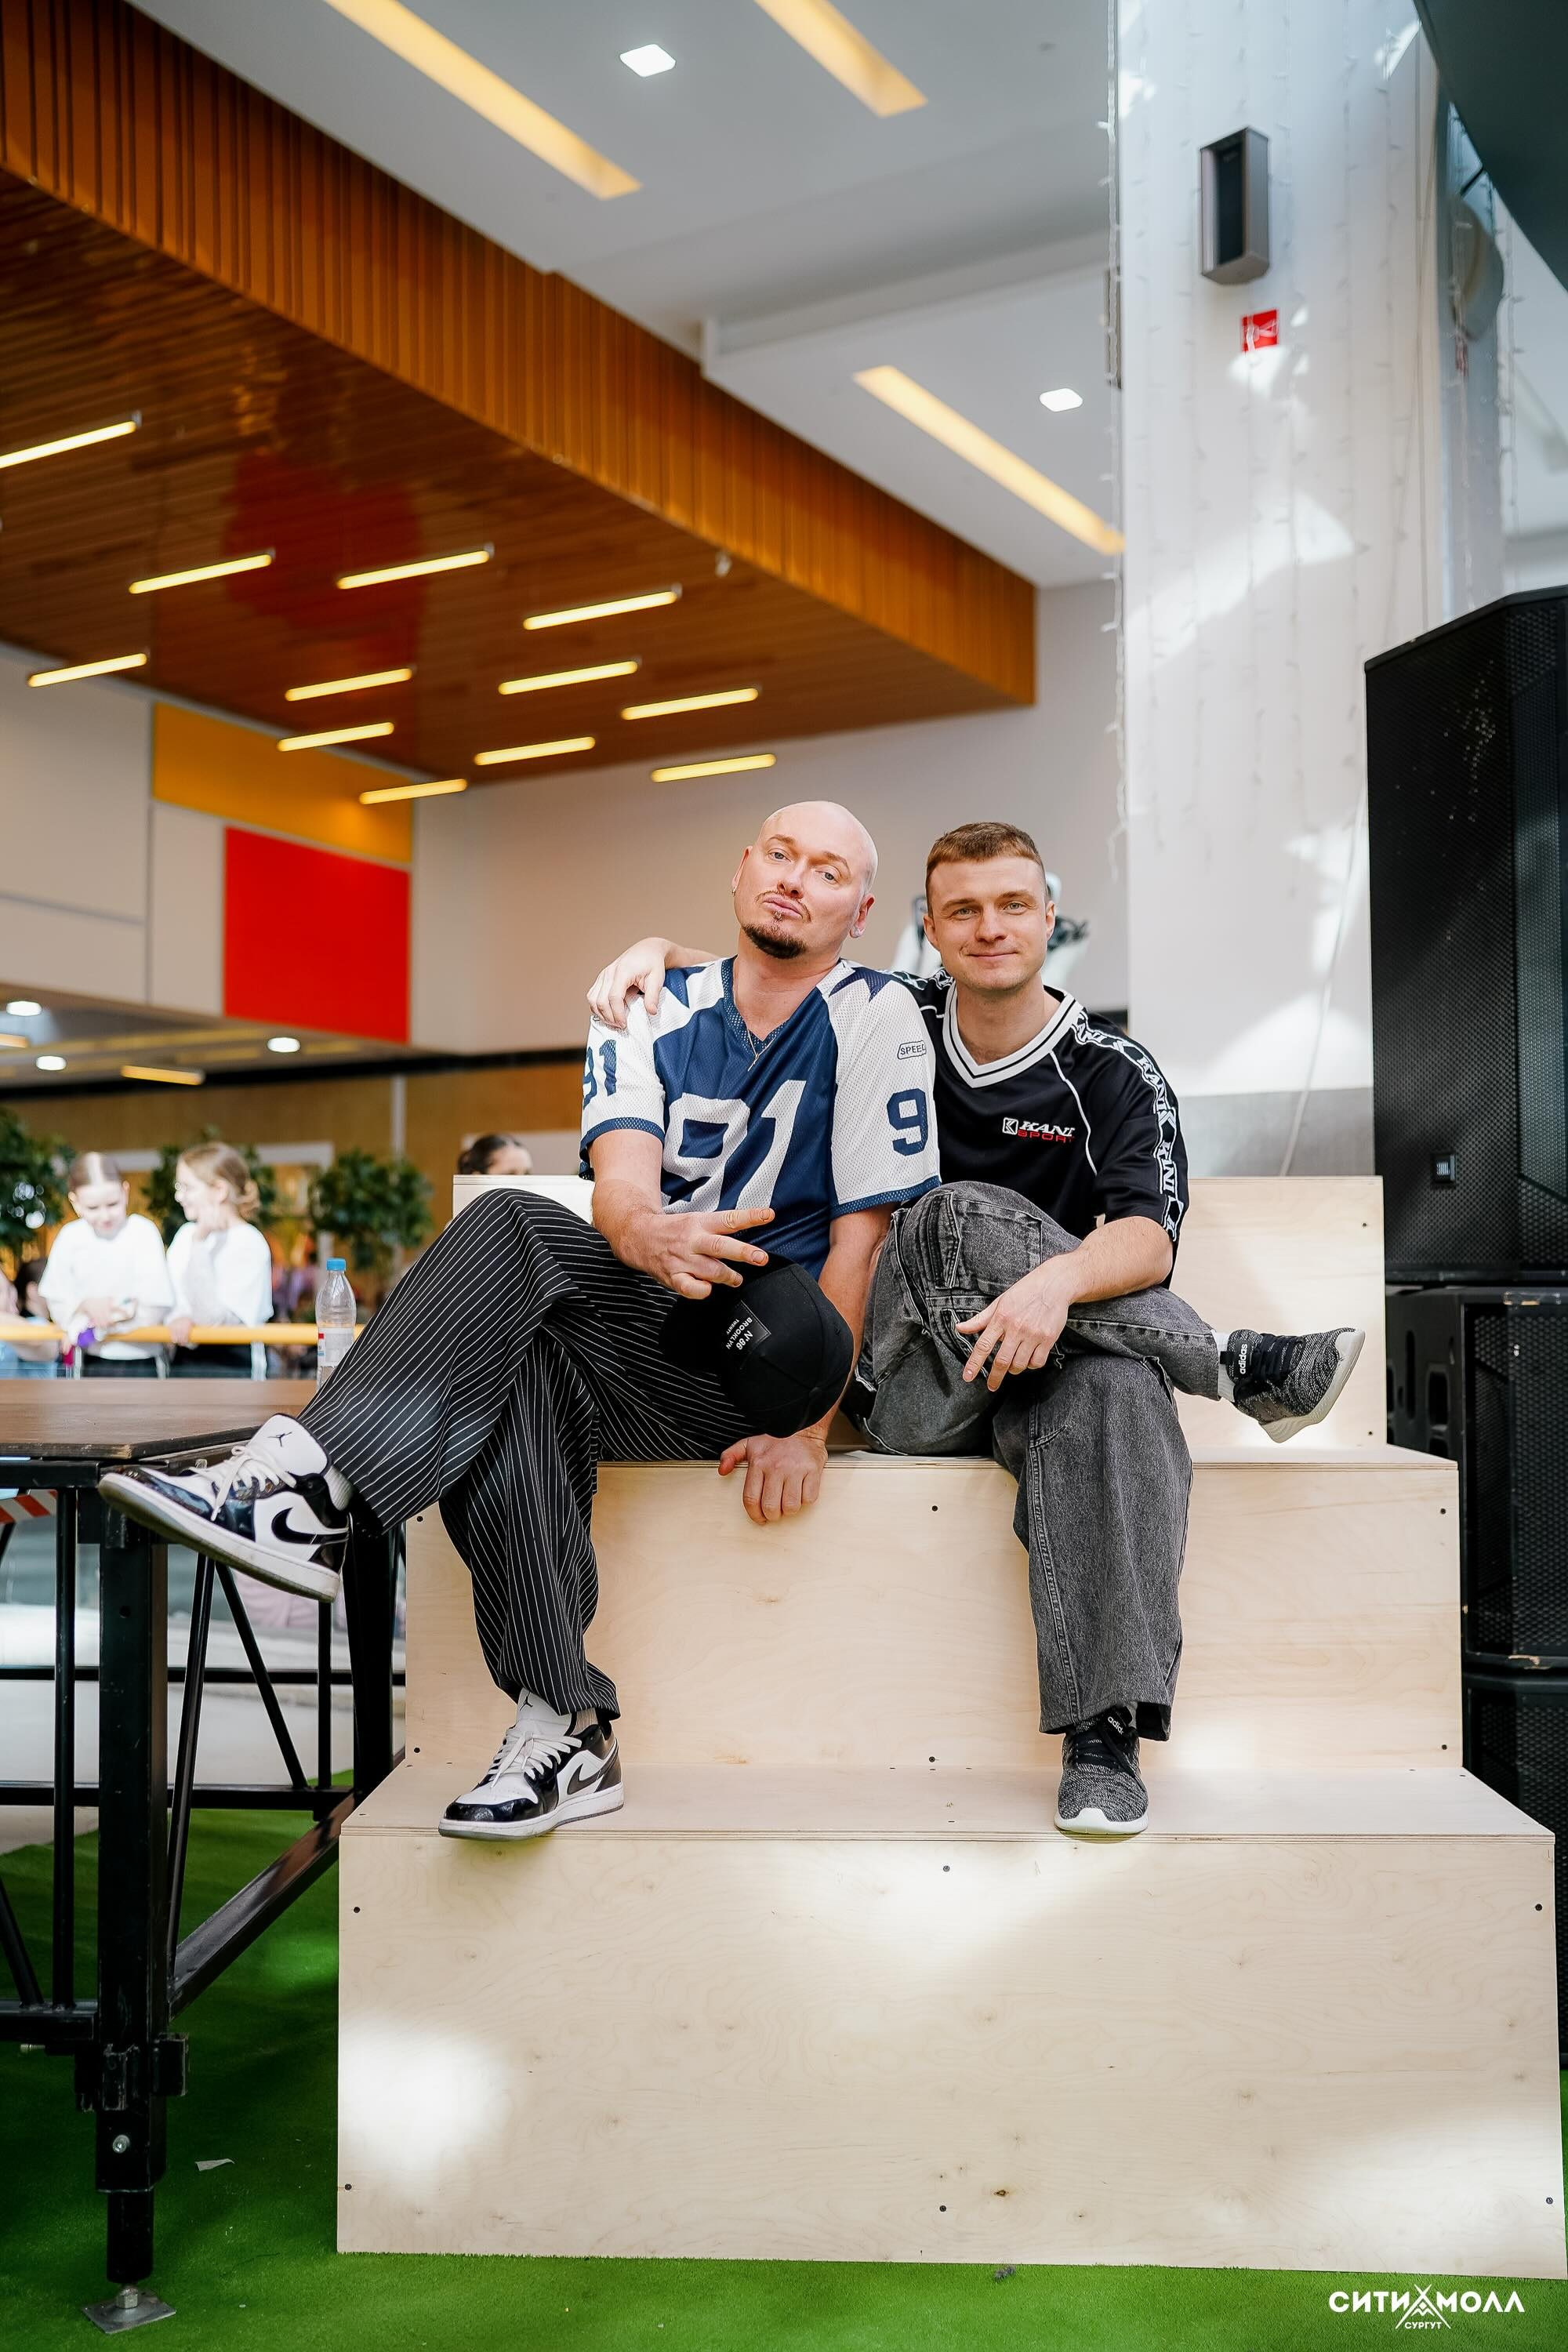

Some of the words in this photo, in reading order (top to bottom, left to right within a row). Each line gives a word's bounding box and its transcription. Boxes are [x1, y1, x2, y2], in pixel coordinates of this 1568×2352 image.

[886, 1087, 928, 1156] 9
[1019, 1121, 1075, 1137] KANI
[662, 1079, 807, 1213] 91
[725, 1316, 753, 1349] BROOKLYN
[1239, 1343, 1248, 1374] adidas
[1107, 1715, 1124, 1735] adid
